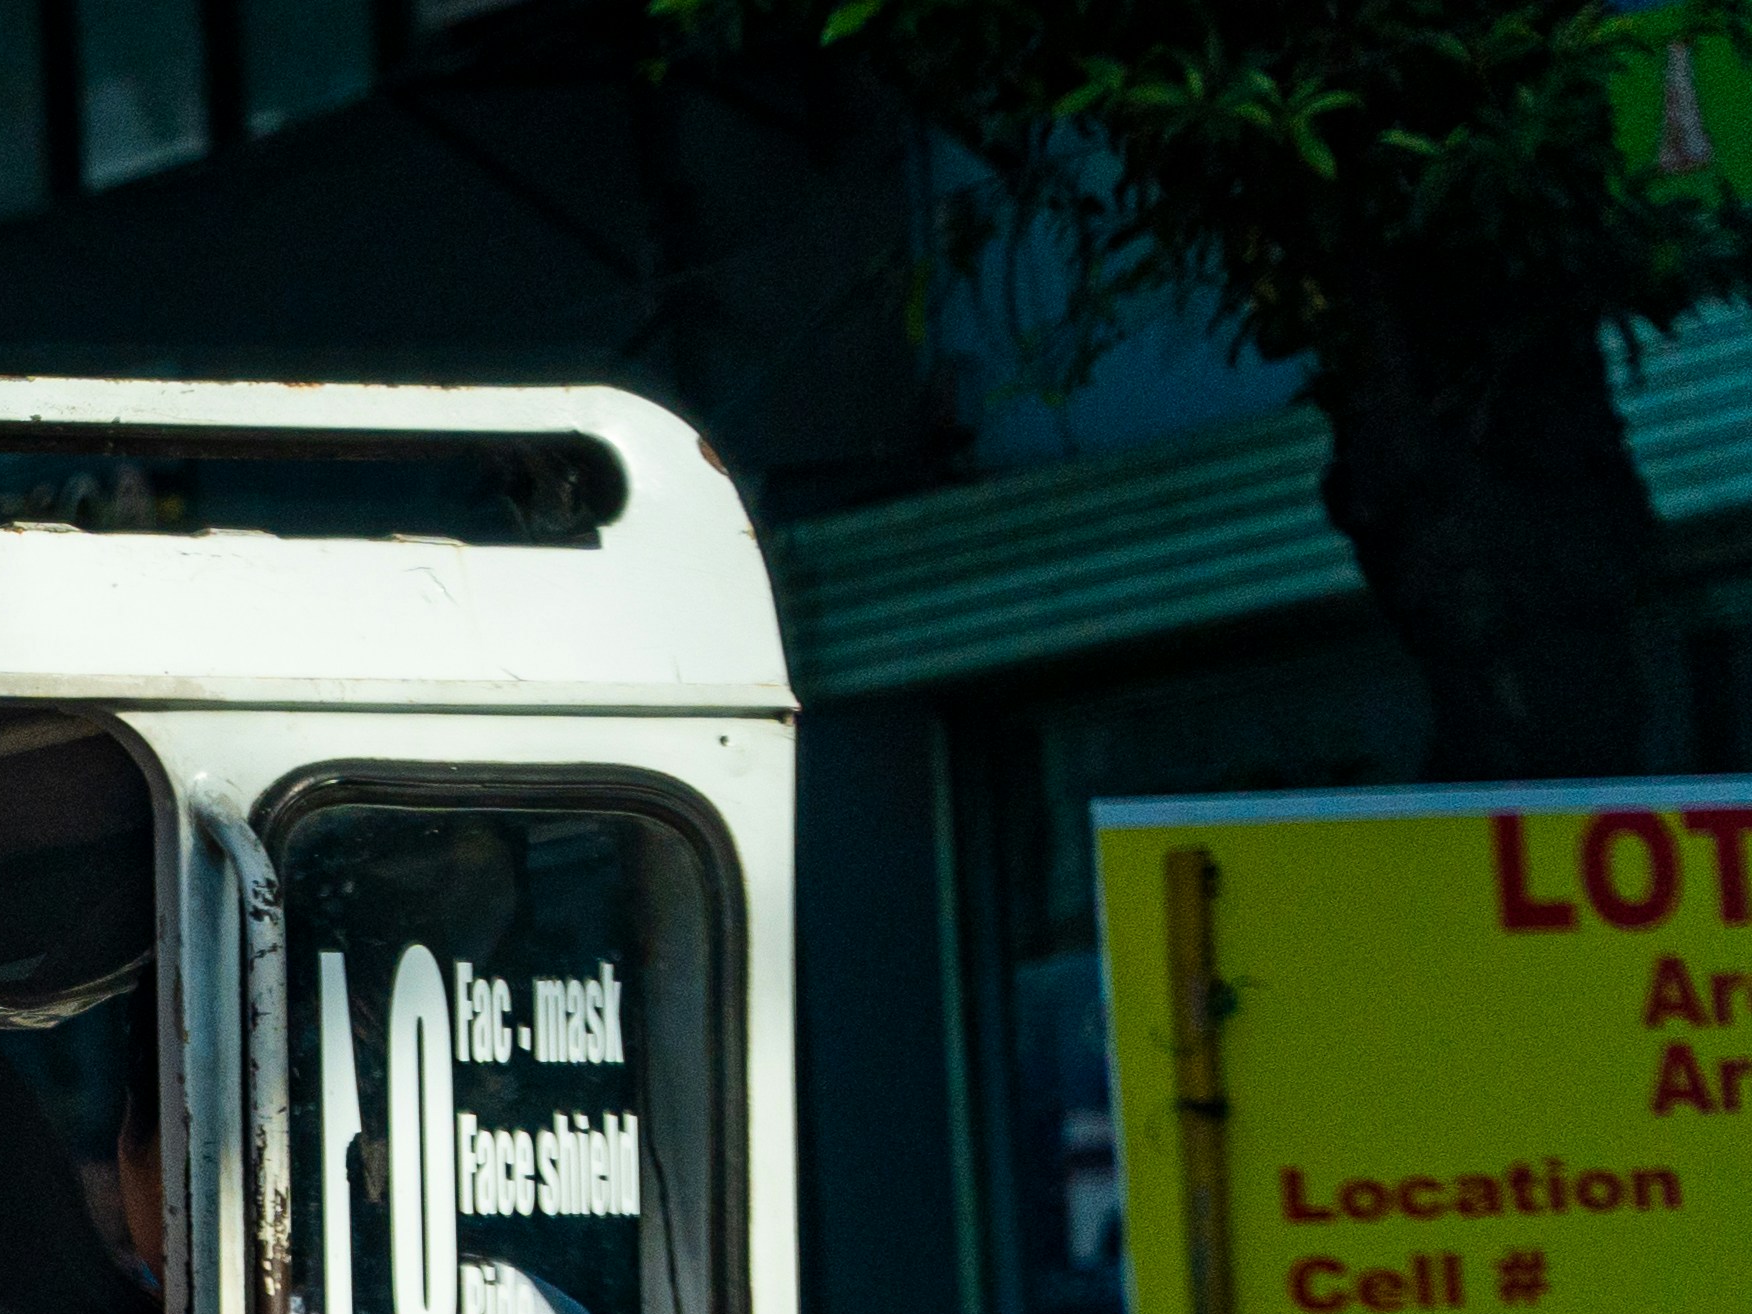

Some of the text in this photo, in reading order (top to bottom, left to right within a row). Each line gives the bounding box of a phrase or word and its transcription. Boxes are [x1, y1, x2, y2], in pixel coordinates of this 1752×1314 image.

[533, 960, 626, 1064] mask
[457, 1109, 641, 1217] Face shield
[1279, 1157, 1684, 1225] Location
[1494, 1247, 1550, 1306] #
